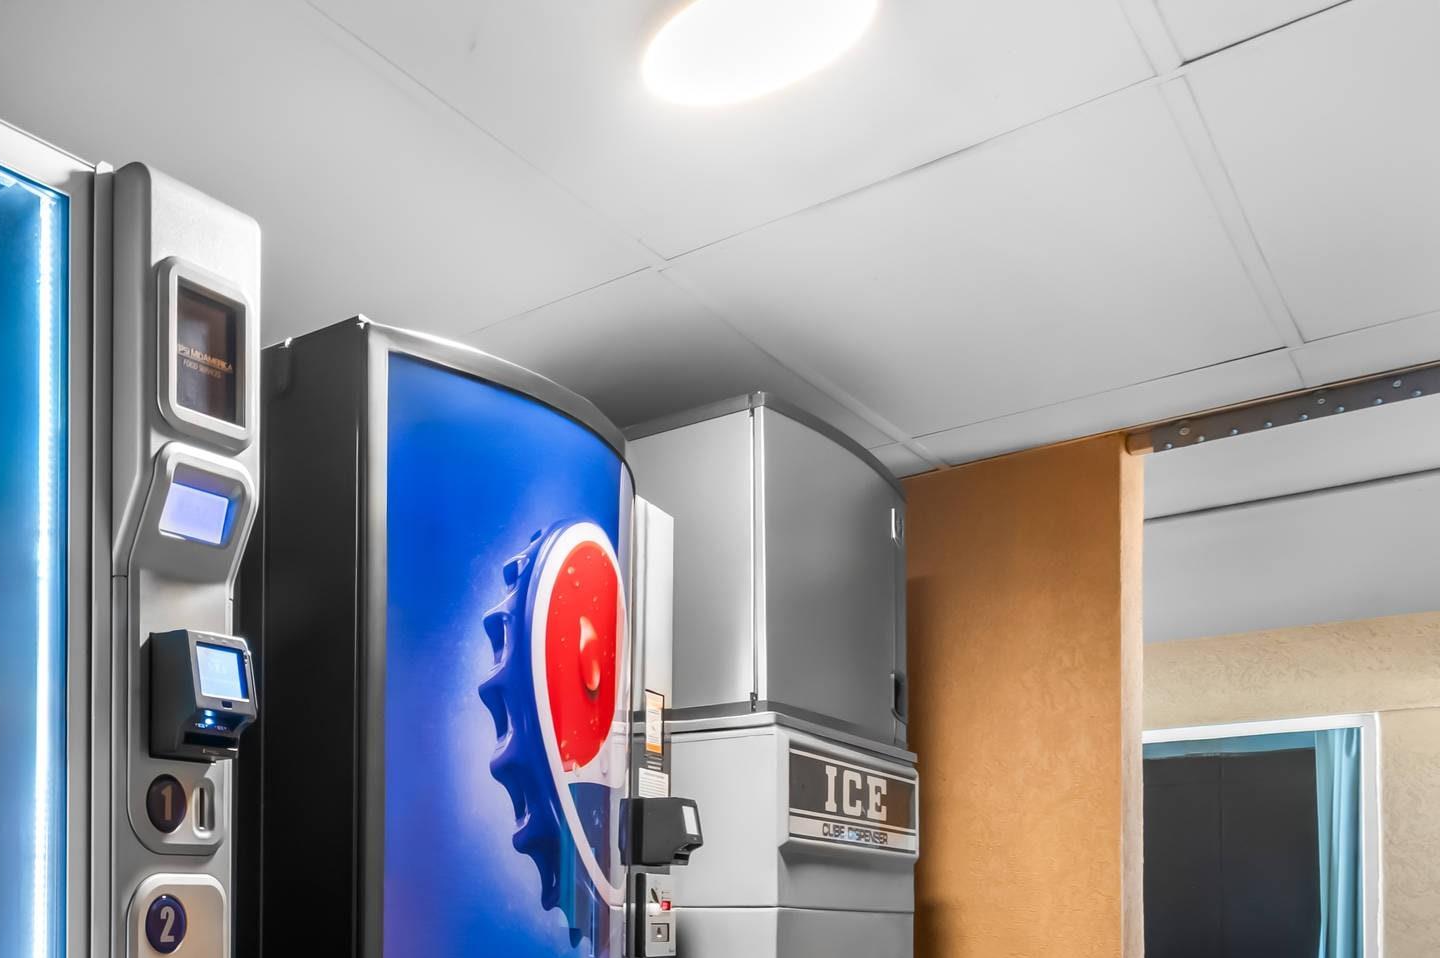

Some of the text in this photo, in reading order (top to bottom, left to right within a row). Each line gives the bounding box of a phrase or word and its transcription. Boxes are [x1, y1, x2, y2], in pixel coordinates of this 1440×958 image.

[161, 785, 173, 820] 1
[825, 765, 887, 821] ICE
[822, 823, 888, 845] CUBE DISPENSER
[160, 906, 175, 942] 2
